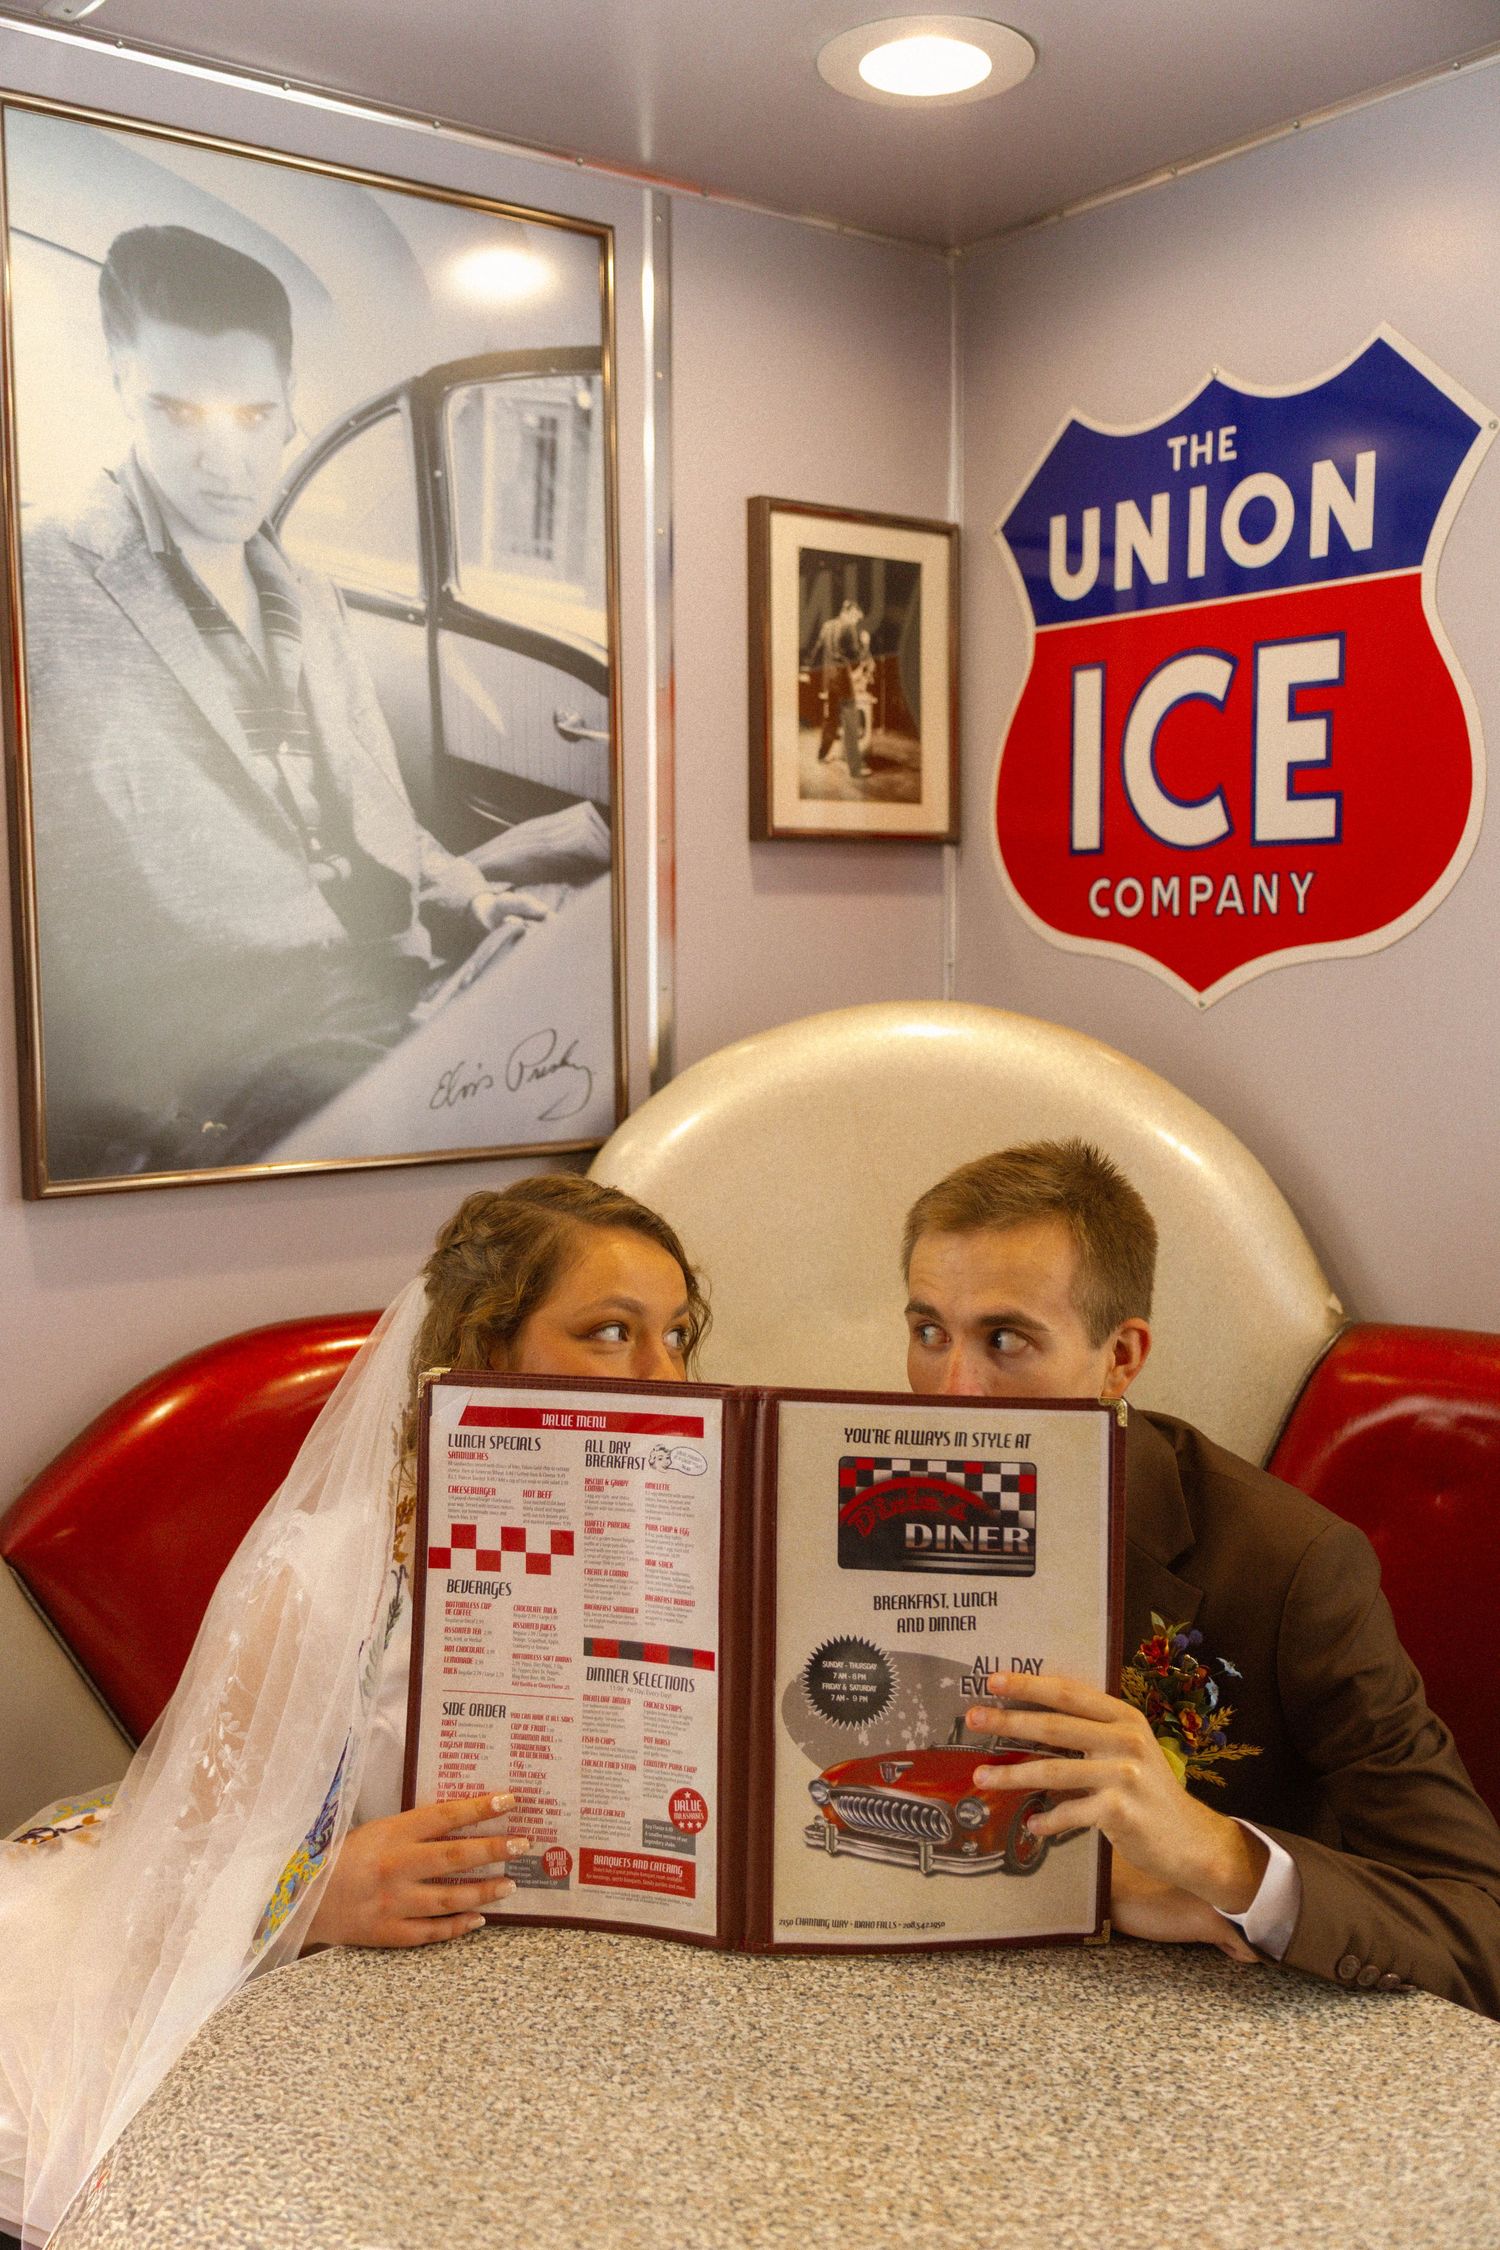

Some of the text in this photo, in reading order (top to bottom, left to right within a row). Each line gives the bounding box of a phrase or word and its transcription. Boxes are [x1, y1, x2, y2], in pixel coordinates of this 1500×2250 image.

[1167, 425, 1238, 472] THE
[1049, 450, 1377, 601] UNION
[1069, 631, 1347, 856] ICE
[1088, 871, 1316, 918] COMPANY
[542, 1413, 606, 1429] VALUE MENU
[447, 1433, 541, 1451] LUNCH SPECIALS
[844, 1427, 1032, 1449] YOU'RE ALWAYS IN STYLE AT
[585, 1439, 631, 1454] ALL DAY
[447, 1450, 489, 1460] SANDWICHES
[585, 1453, 646, 1470] BREAKFAST
[447, 1485, 496, 1497] CHEESEBURGER
[522, 1489, 552, 1499] HOT BEEF
[904, 1522, 1030, 1553] DINER
[446, 1579, 512, 1599] BEVERAGES
[513, 1605, 541, 1613] CHOCOLATE
[873, 1591, 997, 1611] BREAKFAST, LUNCH
[897, 1615, 976, 1633] AND DINNER
[444, 1645, 485, 1654] HOT CHOCOLATE
[822, 1660, 844, 1668] SUNDAY
[849, 1662, 877, 1671] THURSDAY
[1011, 1657, 1043, 1677] DAY
[586, 1666, 629, 1684] DINNER
[632, 1671, 695, 1692] SELECTIONS
[833, 1672, 837, 1680] 7
[822, 1683, 842, 1691] FRIDAY
[849, 1684, 877, 1692] SATURDAY
[442, 1702, 507, 1718] SIDE ORDER
[674, 1799, 702, 1812] VALUE
[550, 1867, 568, 1877] OATS
[593, 1855, 683, 1878] BANQUETS AND CATERING
[795, 1917, 830, 1929] CHANNING
[831, 1920, 849, 1929] WAY
[854, 1920, 876, 1929] IDAHO
[876, 1920, 897, 1929] FALLS
